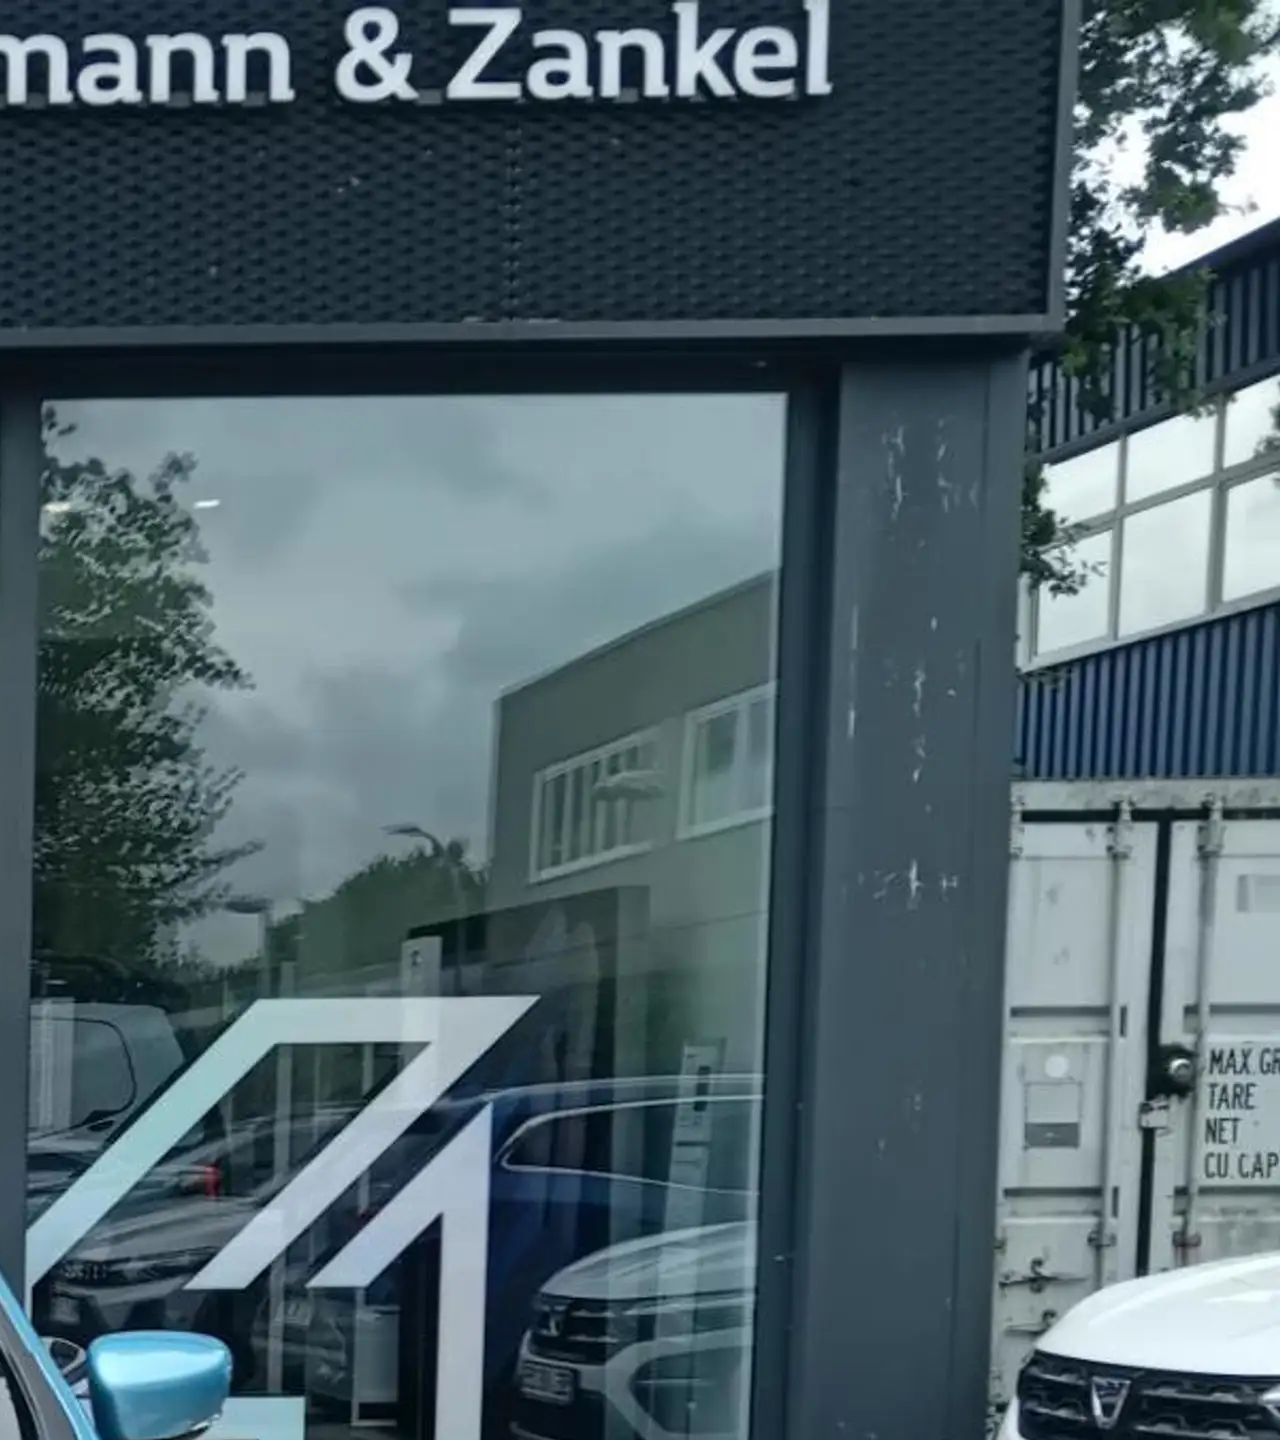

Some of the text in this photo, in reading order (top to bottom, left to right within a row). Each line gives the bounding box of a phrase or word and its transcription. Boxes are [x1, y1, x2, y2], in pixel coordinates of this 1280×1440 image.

[333, 5, 415, 104] &
[445, 0, 834, 104] Zankel
[1208, 1083, 1258, 1110] TARE
[1204, 1117, 1242, 1145] NET
